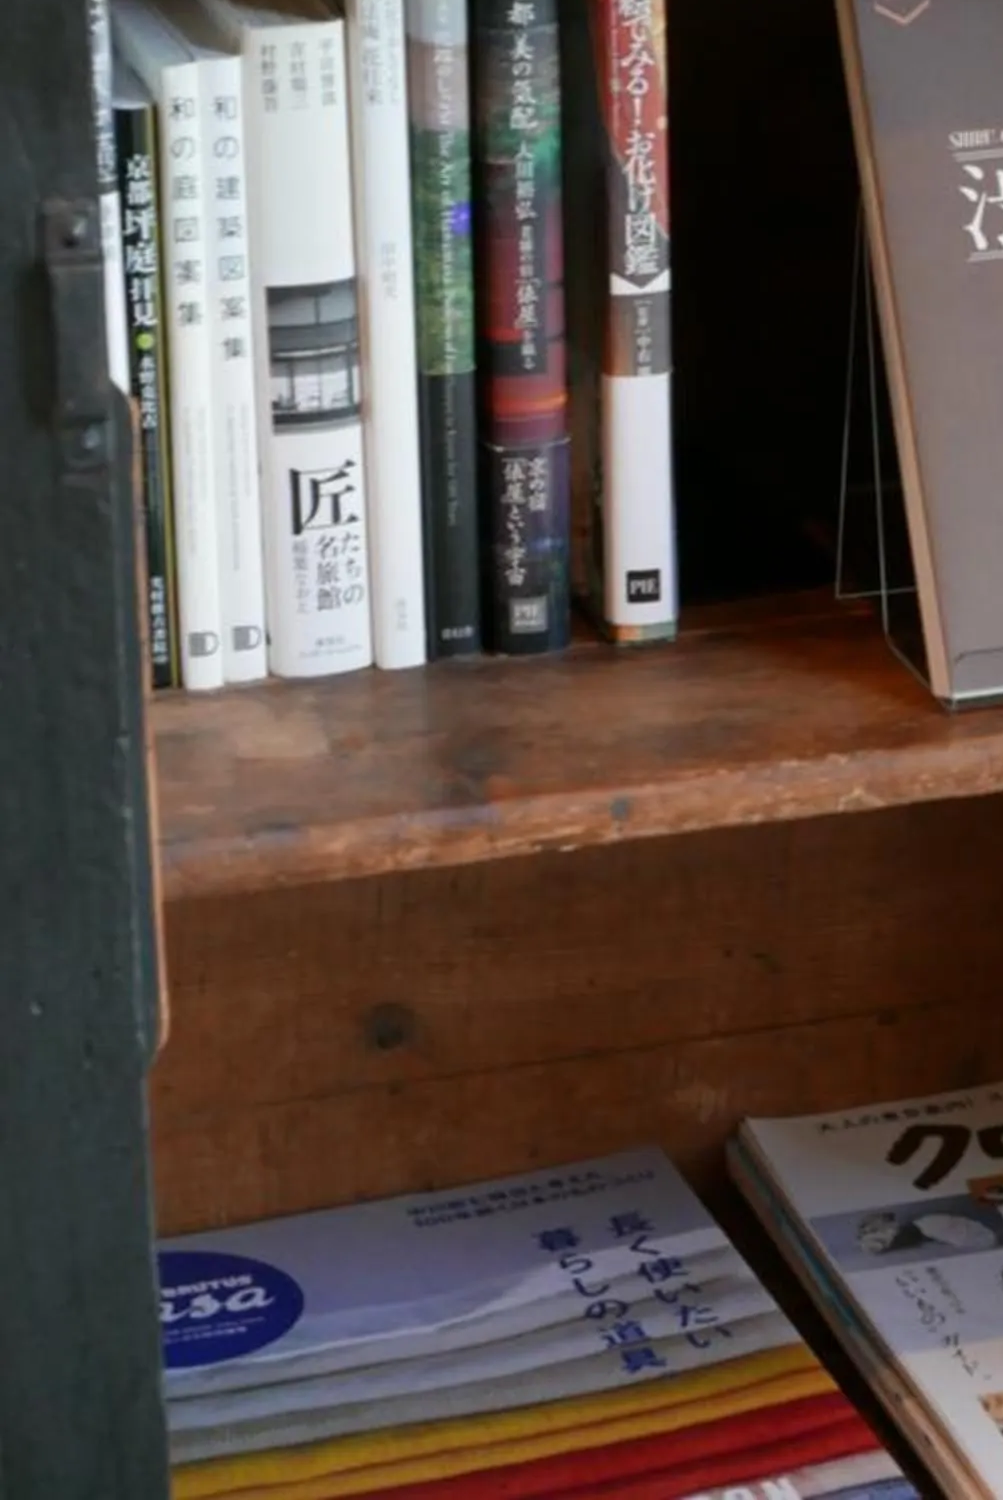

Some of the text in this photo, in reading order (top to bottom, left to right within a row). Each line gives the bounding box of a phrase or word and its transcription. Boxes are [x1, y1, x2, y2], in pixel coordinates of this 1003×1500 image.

[510, 34, 540, 132] 美の気配
[169, 96, 203, 327] 和の庭図案集
[213, 95, 247, 360] 和の建築図案集
[288, 458, 360, 536] 匠
[315, 536, 341, 612] 名旅館
[340, 531, 365, 606] たちの
[531, 1225, 670, 1377] 暮らしの道具
[608, 1210, 733, 1352] 長く使いたい
